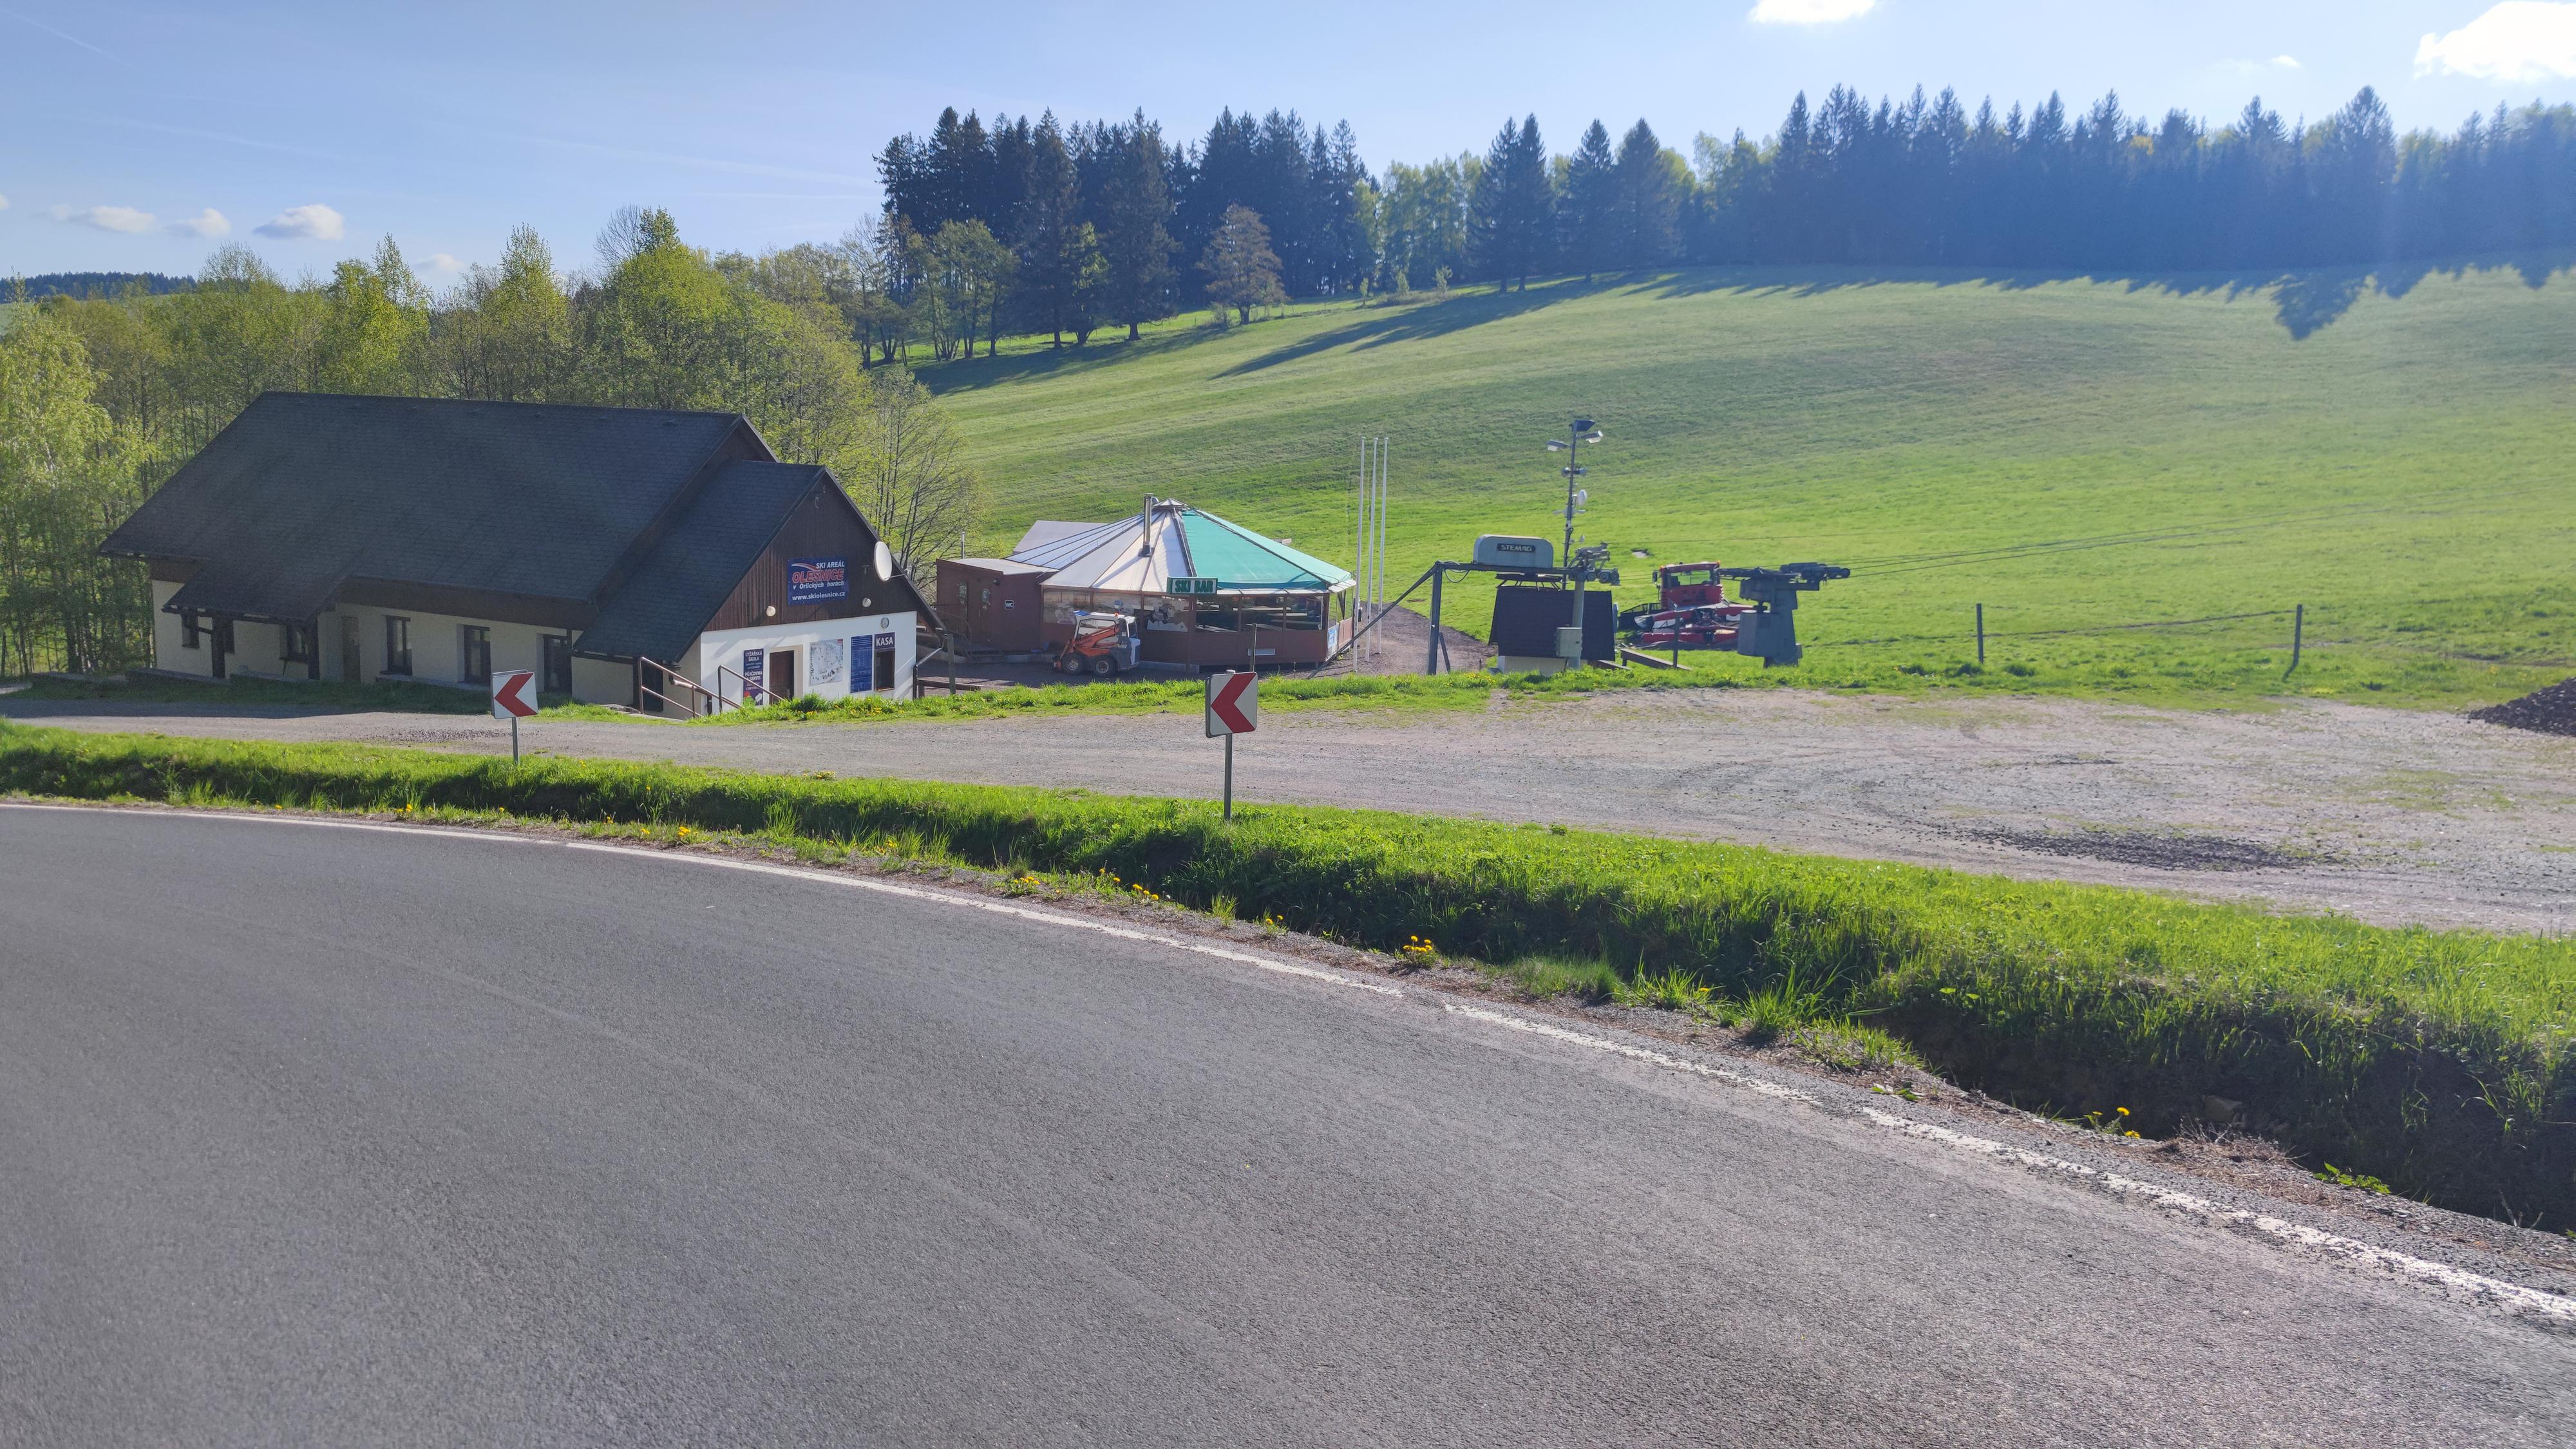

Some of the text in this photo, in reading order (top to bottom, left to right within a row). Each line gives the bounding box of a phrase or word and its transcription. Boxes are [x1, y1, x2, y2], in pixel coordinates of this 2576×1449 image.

[1175, 580, 1213, 592] SKI BAR
[792, 592, 845, 601] www.skiolesnice.cz
[876, 637, 893, 647] KASA
